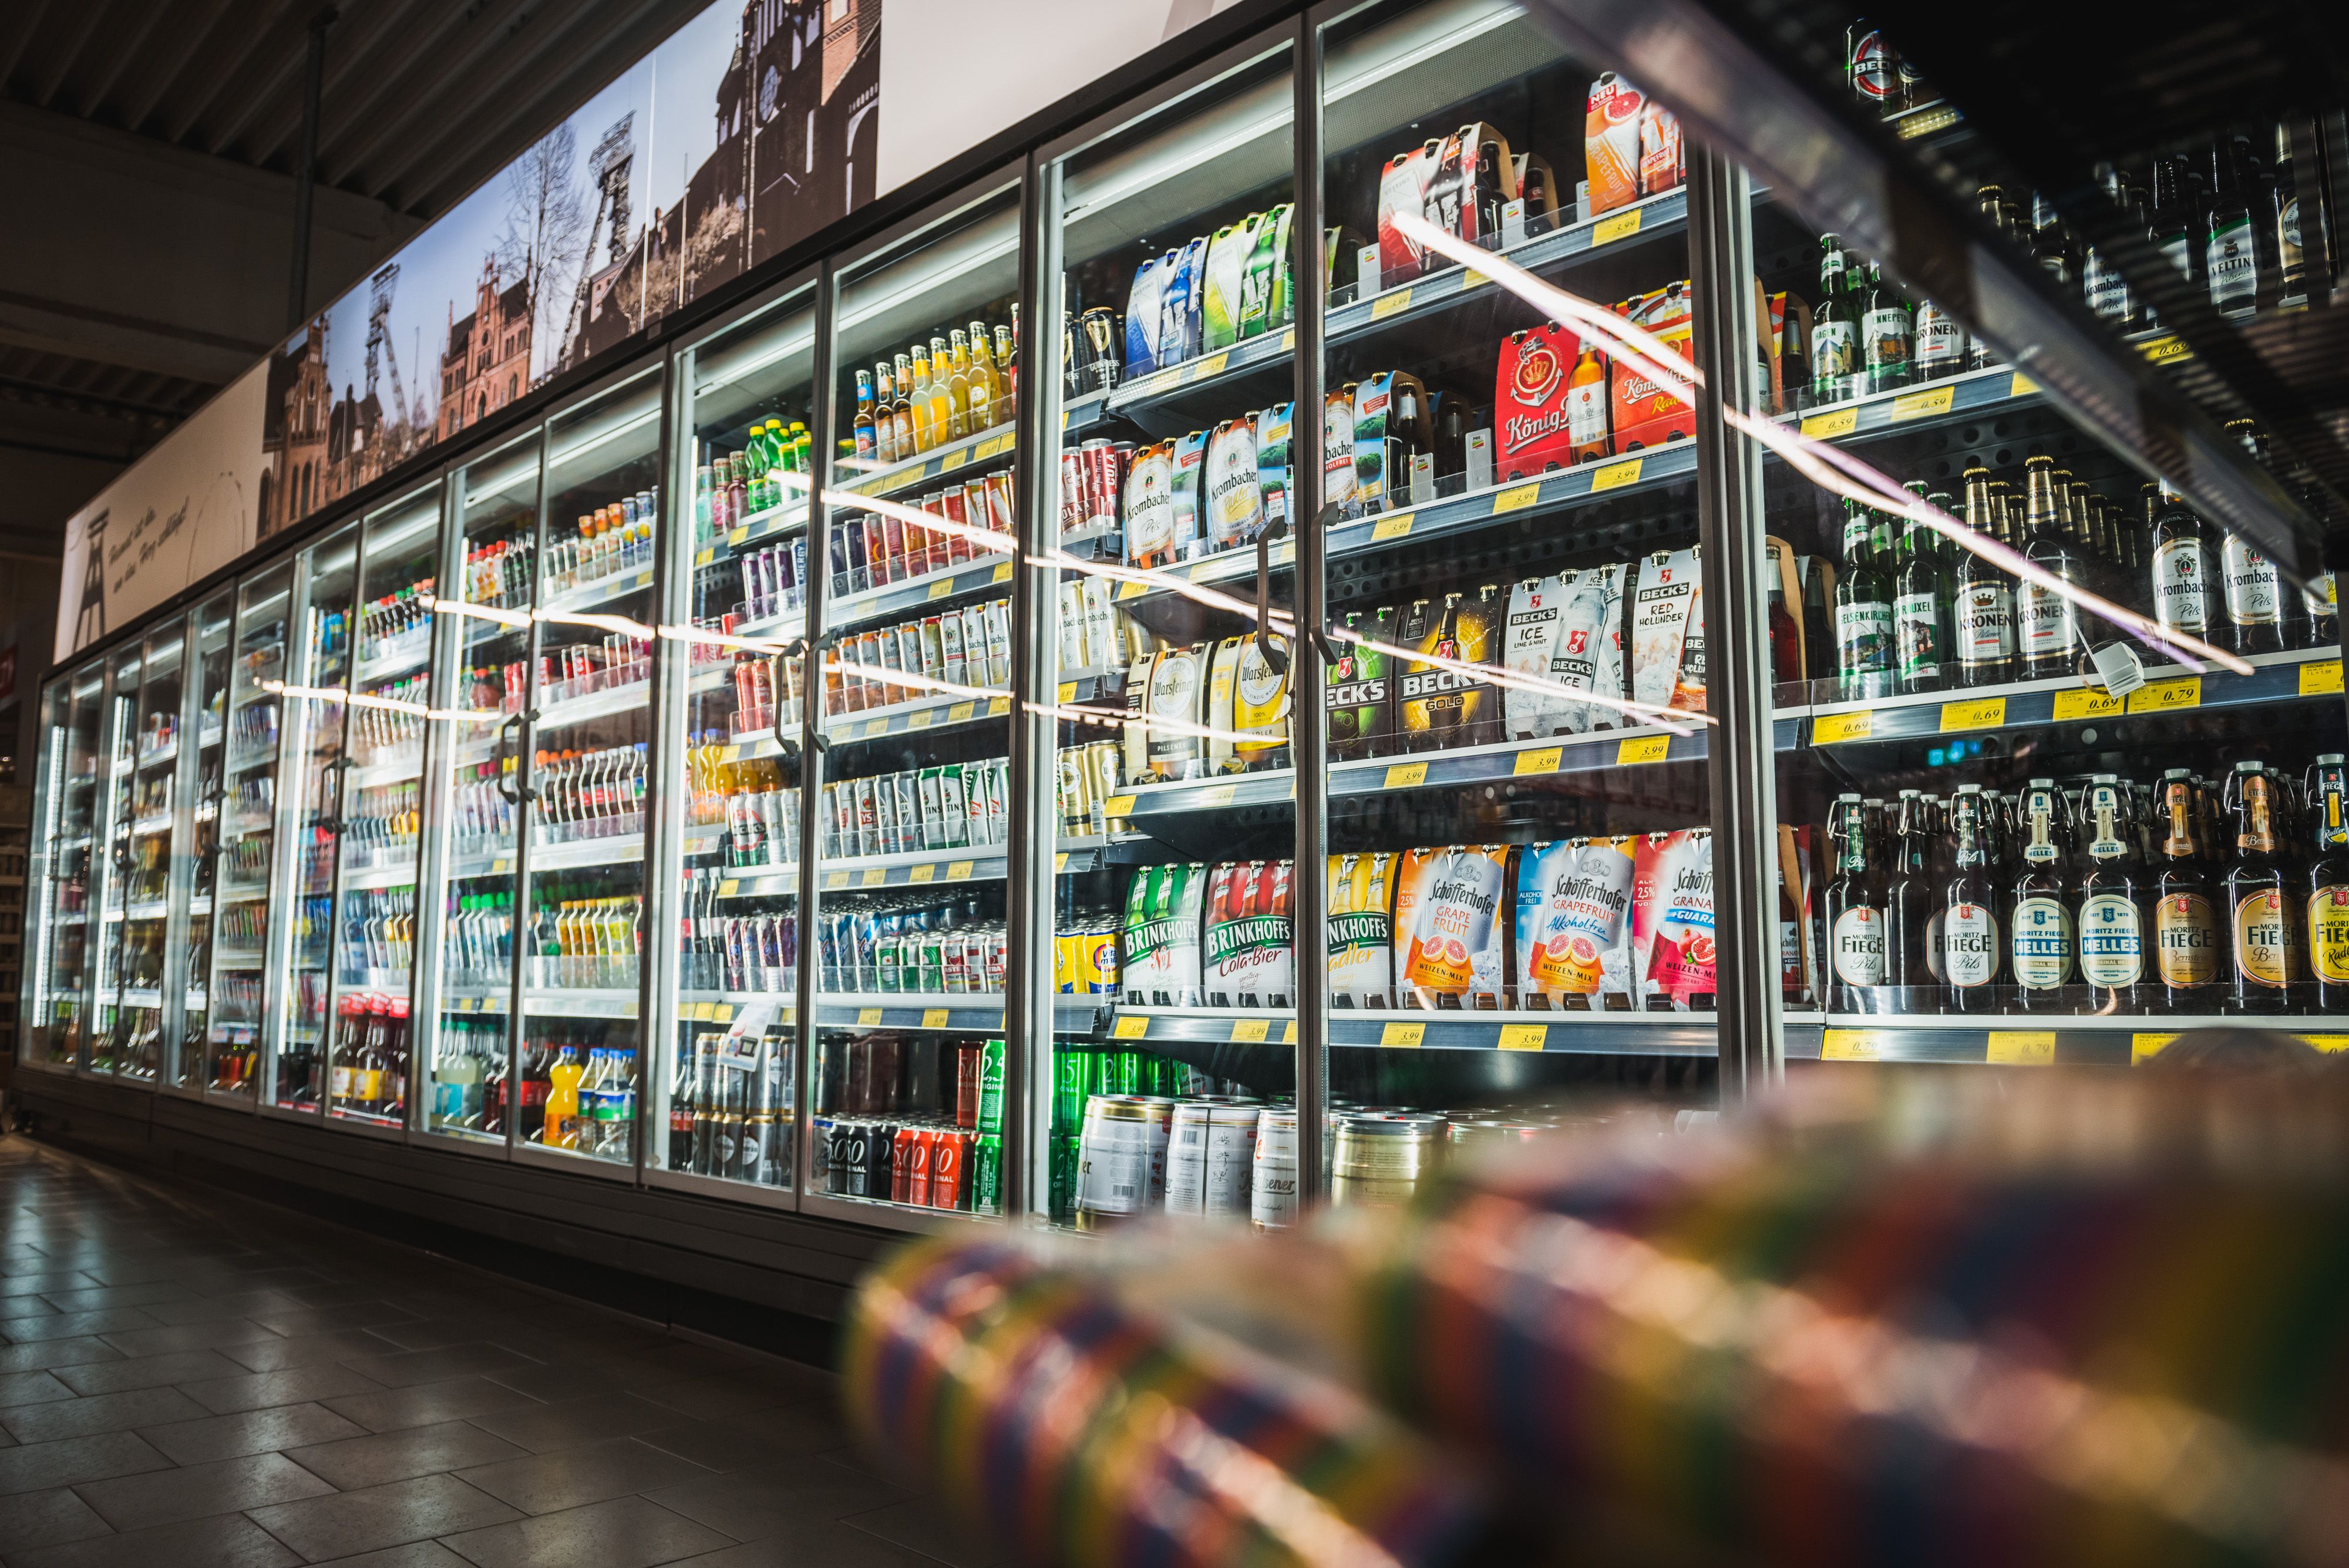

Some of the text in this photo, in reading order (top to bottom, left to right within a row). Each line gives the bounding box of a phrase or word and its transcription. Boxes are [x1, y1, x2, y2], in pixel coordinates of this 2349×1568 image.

[1590, 86, 1615, 105] NEU
[1616, 220, 1635, 233] 3.99
[2086, 278, 2129, 298] Krombach
[1128, 319, 1144, 355] NERGY
[1815, 327, 1836, 339] HAGEN
[1916, 324, 1958, 343] KRONEN
[2159, 342, 2188, 356] 0.69
[1920, 397, 1946, 410] 0.59
[1505, 409, 1560, 447] König
[1828, 417, 1853, 430] 0.59
[1325, 442, 1352, 461] bacher
[1106, 454, 1115, 486] COLA
[1615, 469, 1635, 481] 3.99
[1211, 469, 1257, 502] Krombacher
[1515, 492, 1534, 503] 3.99
[1127, 491, 1170, 522] Krombacher
[1392, 521, 1408, 531] 3.99
[2226, 569, 2287, 588] Krombache
[1640, 584, 1688, 600] BECK'S
[2157, 579, 2215, 598] Krombacher
[2245, 593, 2271, 609] Pils
[1512, 609, 1557, 624] BECK'S
[1651, 604, 1674, 615] RED
[2019, 606, 2069, 625] KRONEN
[2175, 604, 2200, 618] Pils
[1063, 617, 1085, 628] bacher
[1088, 611, 1114, 625] mbacher
[1639, 613, 1683, 626] HOLUNDER
[1960, 614, 2012, 631] KRONEN
[1520, 627, 1543, 640] ICE
[968, 640, 985, 650] bacher
[1552, 661, 1592, 675] BECK'S
[1155, 679, 1193, 697] Warsteiner
[1560, 676, 1580, 688] ICE
[1327, 681, 1384, 706] ECK'S
[2163, 688, 2194, 701] 0.79
[1426, 696, 1464, 712] GOLD
[2089, 698, 2118, 709] 0.69
[1973, 709, 2000, 721] 0.69
[1844, 720, 1869, 733] 0.69
[1157, 742, 1186, 752] PILSENER
[1641, 745, 1664, 756] 3.99
[1537, 757, 1557, 768] 3.99
[1404, 770, 1422, 780] 3.99
[2322, 782, 2344, 790] FIEGE
[925, 805, 942, 815] TINS
[946, 803, 965, 812] TINS
[2321, 827, 2345, 842] Radler
[1428, 878, 1496, 917] Schöfferhofer
[1553, 874, 1626, 913] Schöfferhofer
[1637, 887, 1655, 898] 2,5%
[1401, 896, 1414, 906] 2,5%
[1436, 906, 1470, 924] GRAPE
[1553, 899, 1615, 923] GRAPEFRUIT
[1328, 917, 1387, 945] NKHOFF'S
[1432, 917, 1469, 937] FRUIT
[1546, 914, 1607, 935] Alkoholfrei
[1124, 920, 1197, 957] BRINKHOFF'S
[1206, 920, 1290, 957] BRINKHOFF'S
[2160, 929, 2213, 948] FIEGE
[2247, 926, 2298, 945] FIEGE
[1842, 937, 1882, 954] FIEGE
[1947, 935, 1992, 952] FIEGE
[2016, 941, 2068, 954] HELLES
[2084, 939, 2139, 952] HELLES
[1219, 945, 1282, 977] Cola+Bier
[1329, 941, 1377, 972] adler
[1850, 954, 1877, 970] Pils
[1953, 954, 1983, 969] Pils
[1127, 962, 1148, 978] PREMIUM
[1419, 963, 1463, 982] WEIZEN-MIX
[1543, 963, 1593, 982] WEIZEN-MIX
[1666, 962, 1716, 980] WEIZEN-MI
[1401, 1032, 1419, 1041] 3.99
[1522, 1035, 1542, 1044] 3.99
[1852, 1041, 1878, 1052] 0.79
[2021, 1042, 2050, 1055] 0.79
